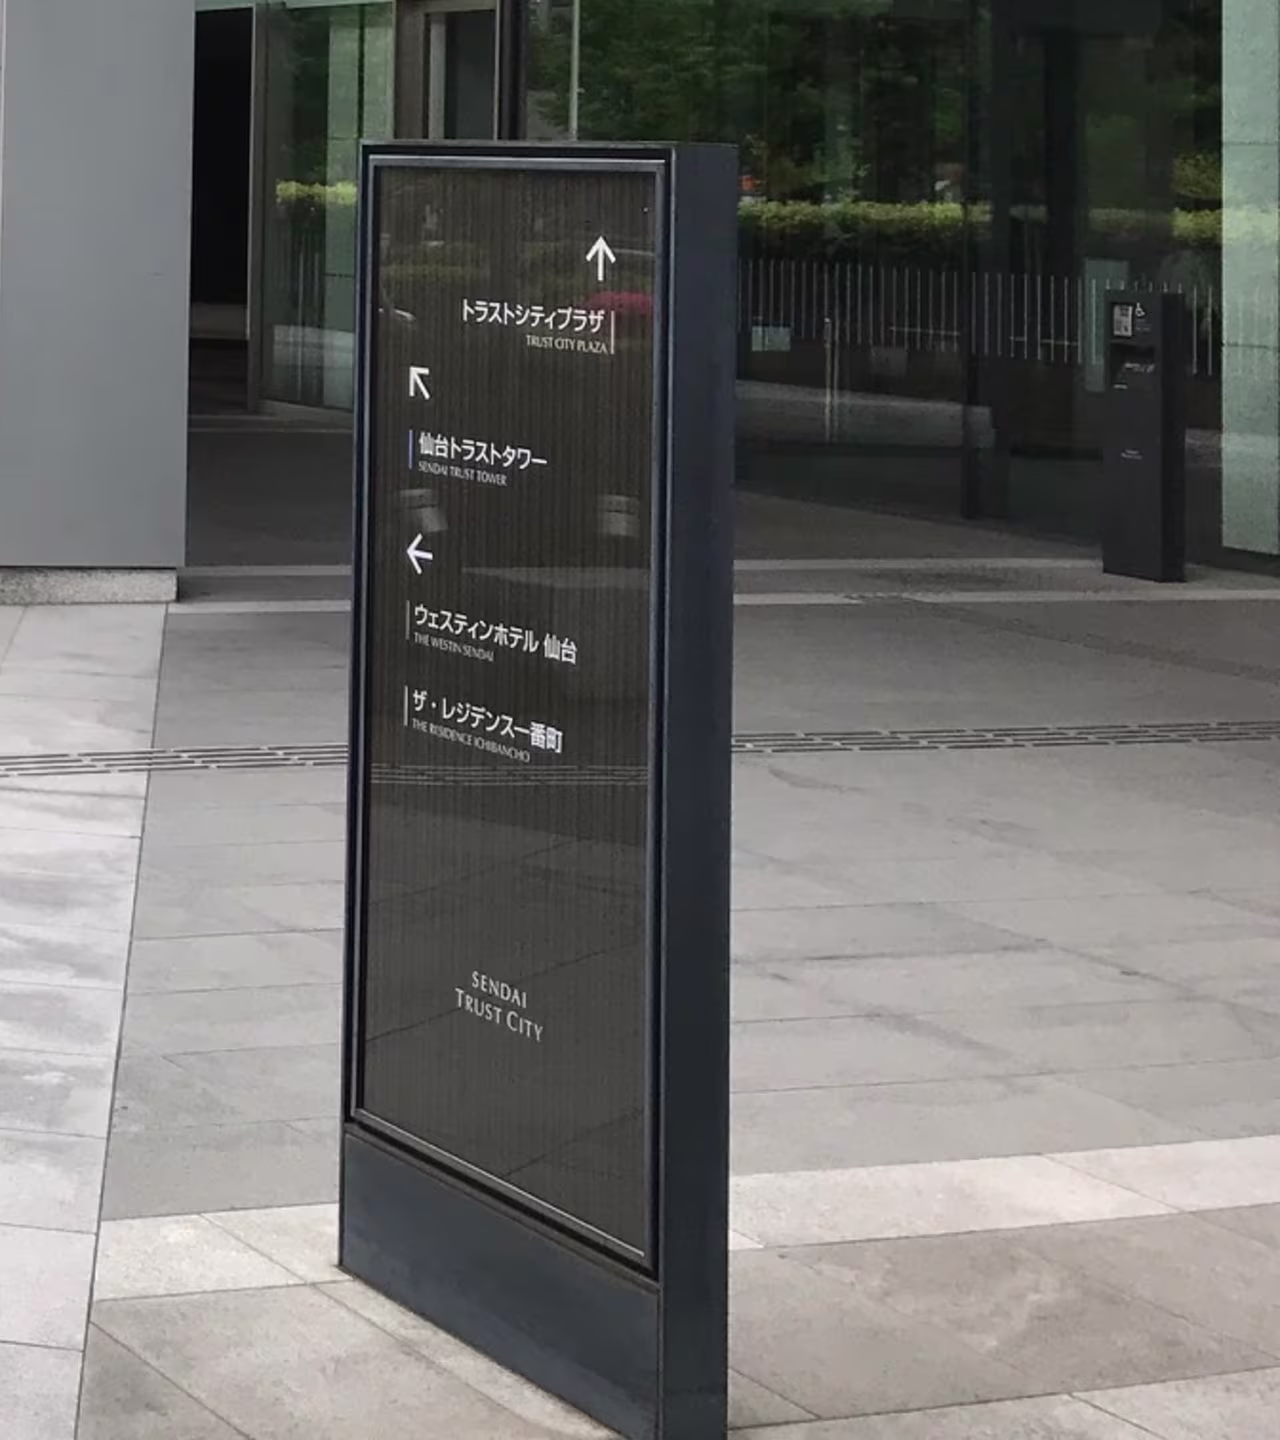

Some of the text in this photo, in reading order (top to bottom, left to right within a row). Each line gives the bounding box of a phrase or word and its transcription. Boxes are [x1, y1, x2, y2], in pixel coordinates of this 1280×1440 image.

[462, 298, 605, 333] トラストシティプラザ
[526, 334, 608, 354] TRUST CITY PLAZA
[419, 431, 548, 470] 仙台トラストタワー
[418, 460, 508, 486] SENDAI TRUST TOWER
[414, 603, 578, 665] ウェスティンホテル 仙台
[414, 631, 494, 662] THE WESTIN SENDAI
[412, 717, 428, 733] THE
[471, 970, 527, 1009] SENDAI
[454, 987, 544, 1042] TRUST CITY
